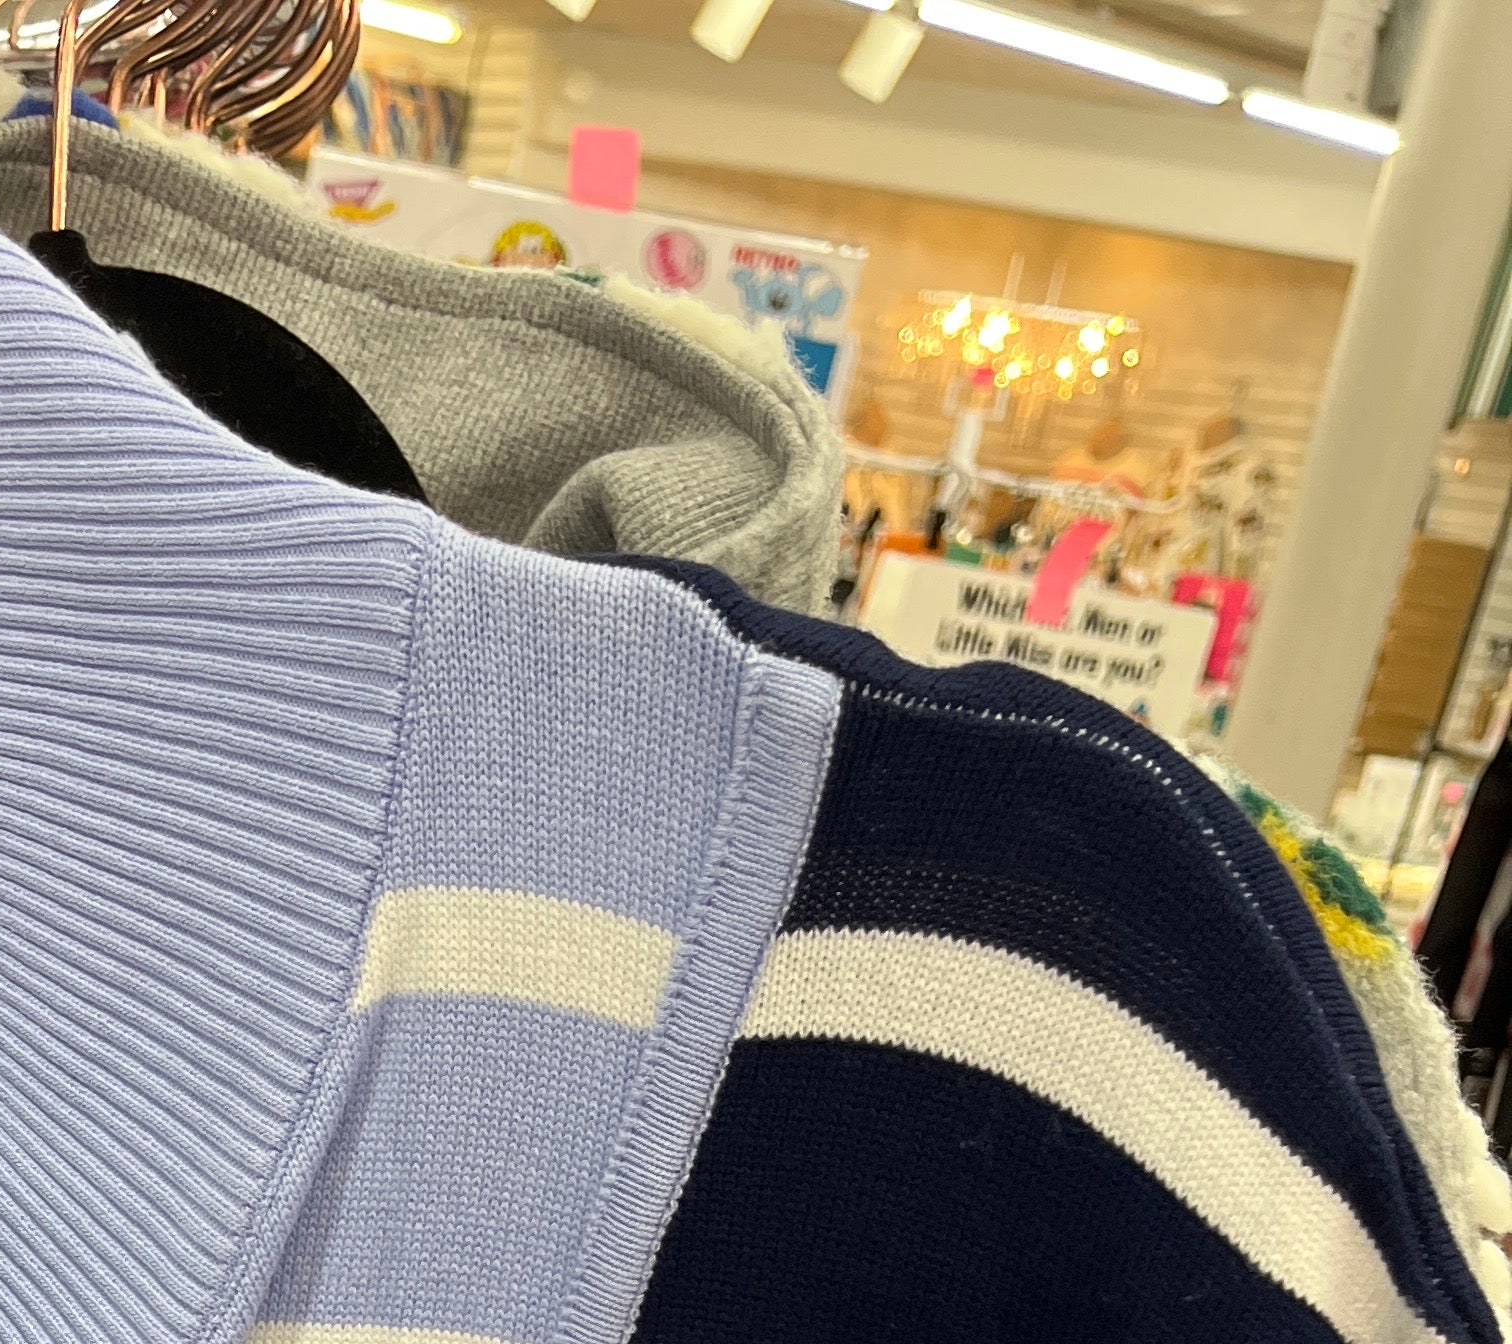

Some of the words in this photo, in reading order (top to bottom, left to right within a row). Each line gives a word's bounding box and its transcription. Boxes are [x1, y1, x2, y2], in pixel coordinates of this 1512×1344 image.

[961, 583, 1029, 620] Which
[936, 619, 995, 656] Little
[1059, 648, 1099, 676] are
[1103, 652, 1166, 688] you?
